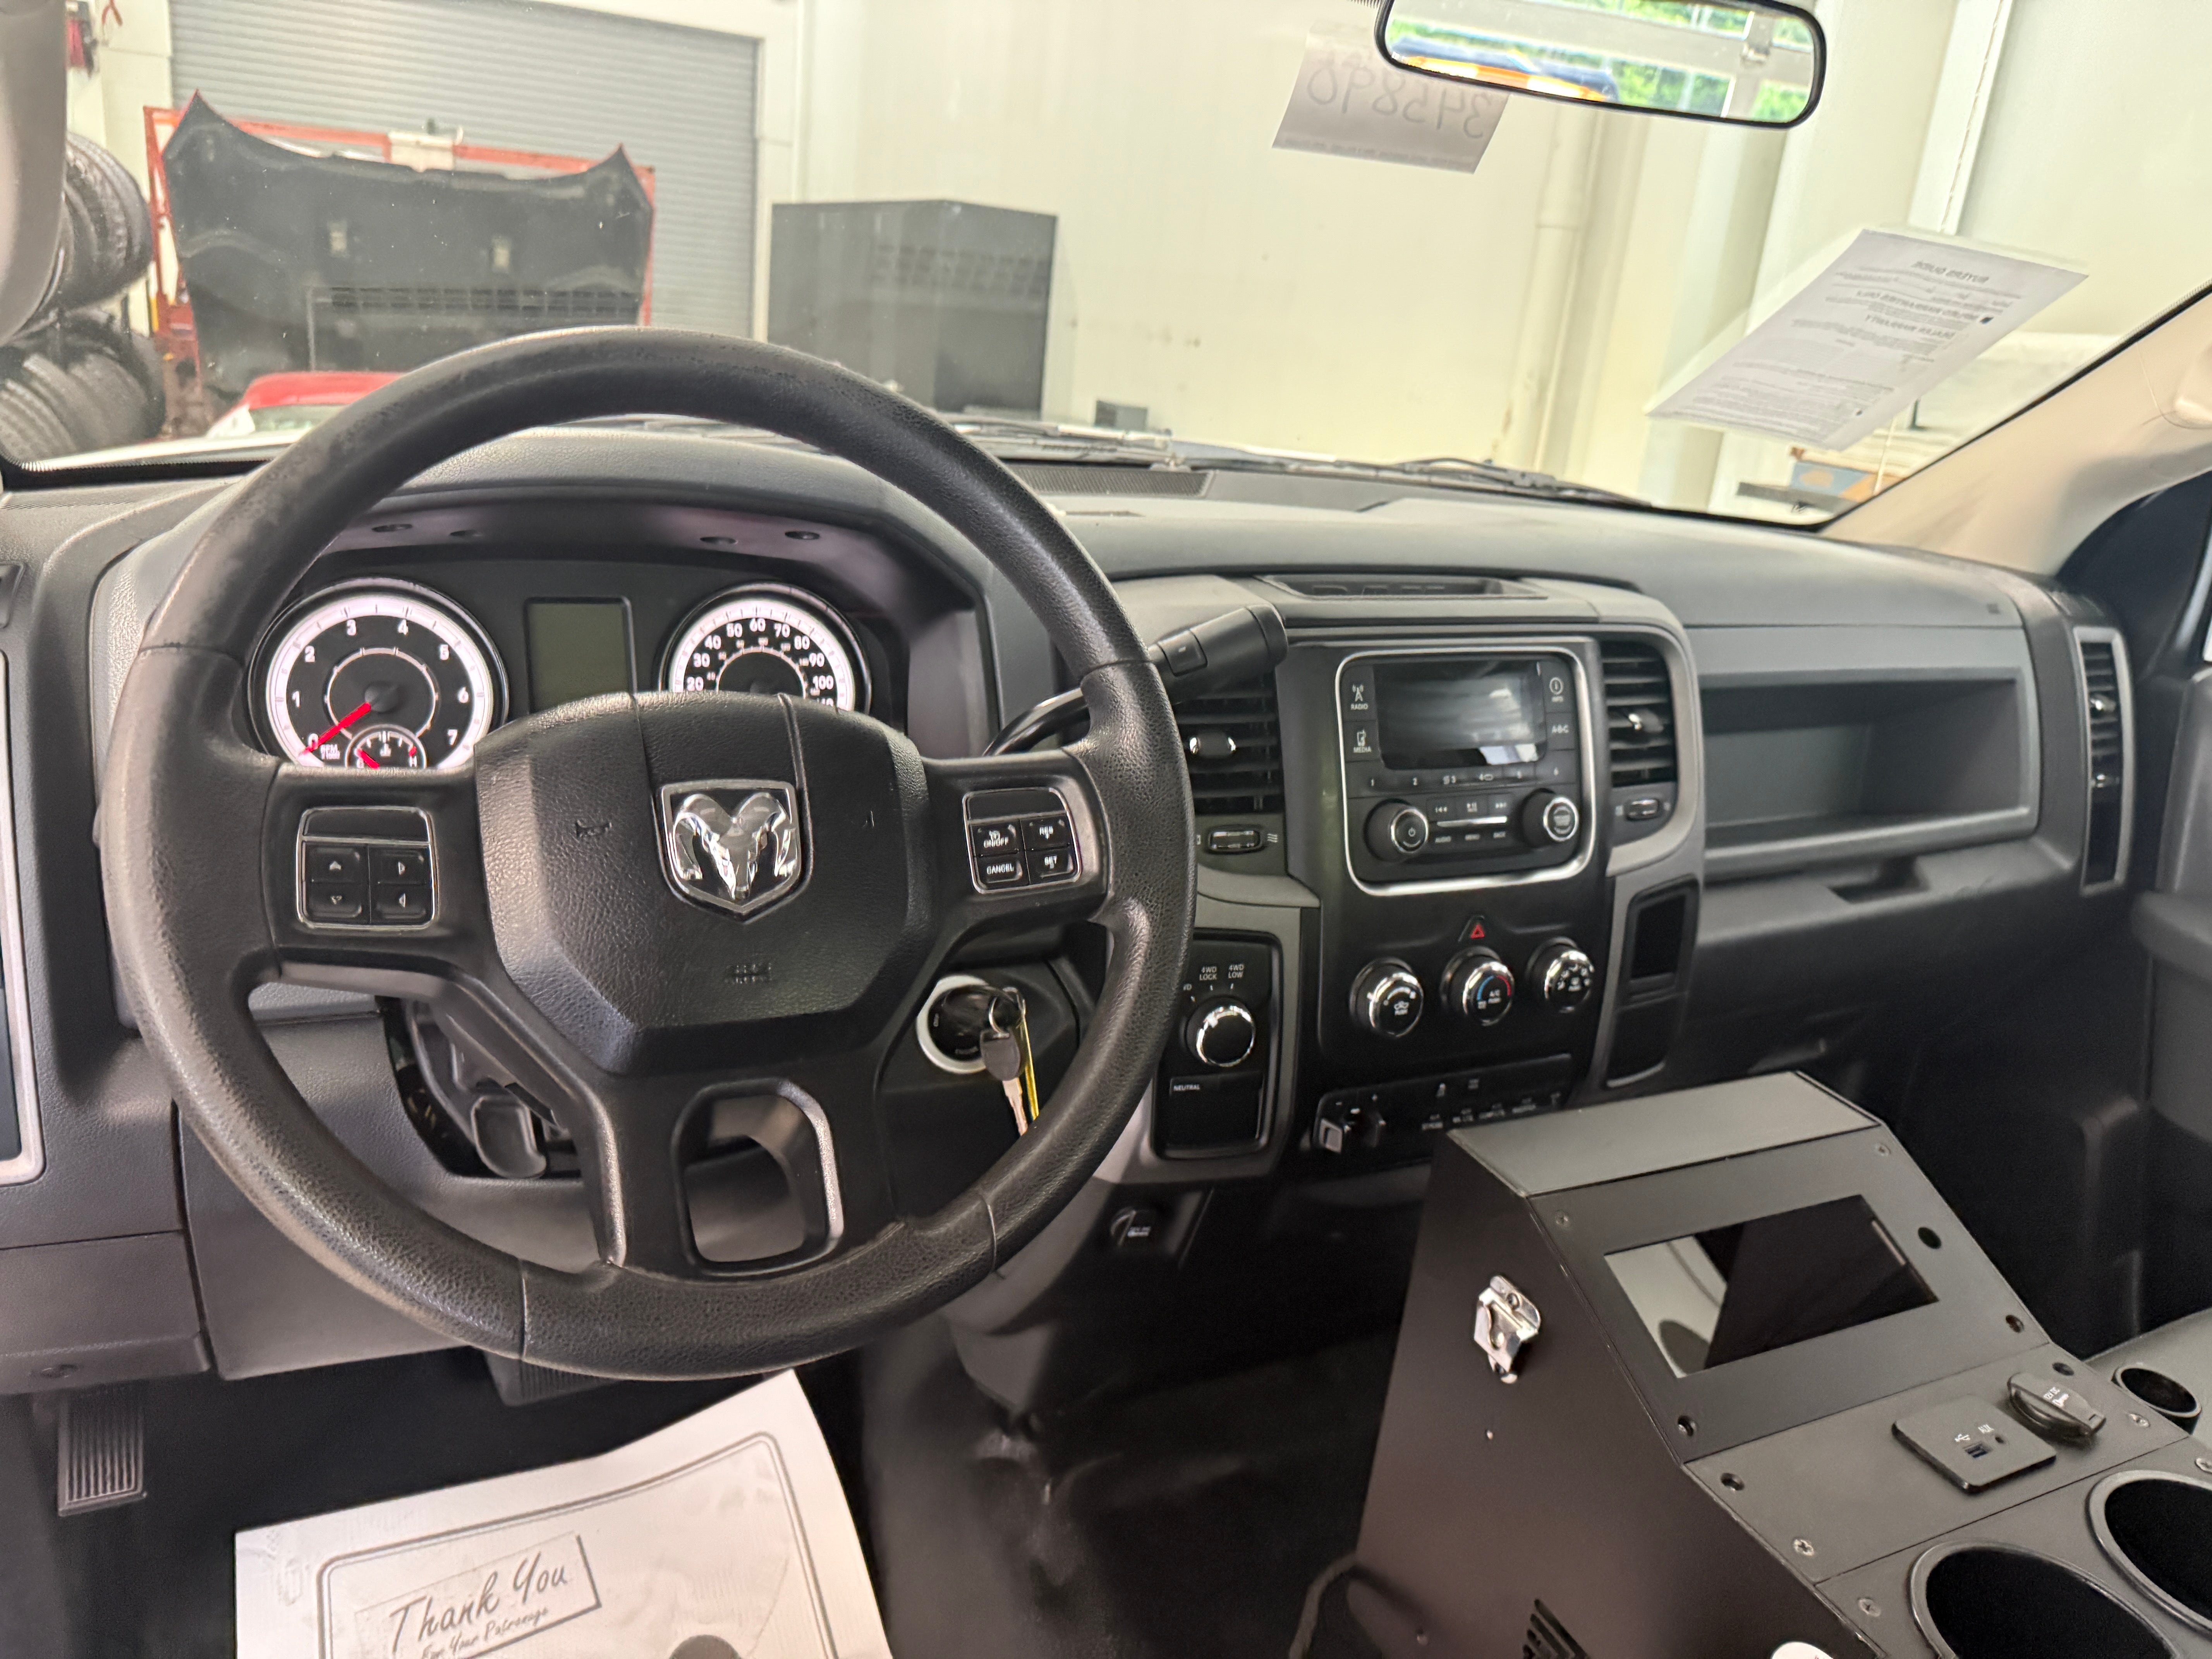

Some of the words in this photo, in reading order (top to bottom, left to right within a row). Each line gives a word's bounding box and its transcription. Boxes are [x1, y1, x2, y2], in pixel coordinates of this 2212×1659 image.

[347, 619, 356, 636] 3
[398, 619, 408, 635] 4
[726, 623, 743, 637] 50
[749, 618, 766, 632] 60
[774, 623, 790, 638] 70
[704, 635, 721, 649] 40
[794, 635, 810, 650] 80
[304, 646, 315, 663] 2
[439, 644, 449, 660] 5
[693, 653, 710, 667] 30
[809, 653, 825, 667] 90
[687, 677, 704, 691] 20
[813, 675, 834, 690] 100
[292, 691, 301, 708] 1
[458, 687, 469, 703] 6
[309, 733, 318, 750] 0
[448, 729, 458, 745] 7
[1371, 778, 1374, 787] 1
[1413, 777, 1418, 786] 2
[984, 837, 1008, 848] ON/OFF
[987, 863, 1014, 875] CANCEL
[389, 1570, 500, 1655] Thank
[513, 1551, 568, 1603] You
